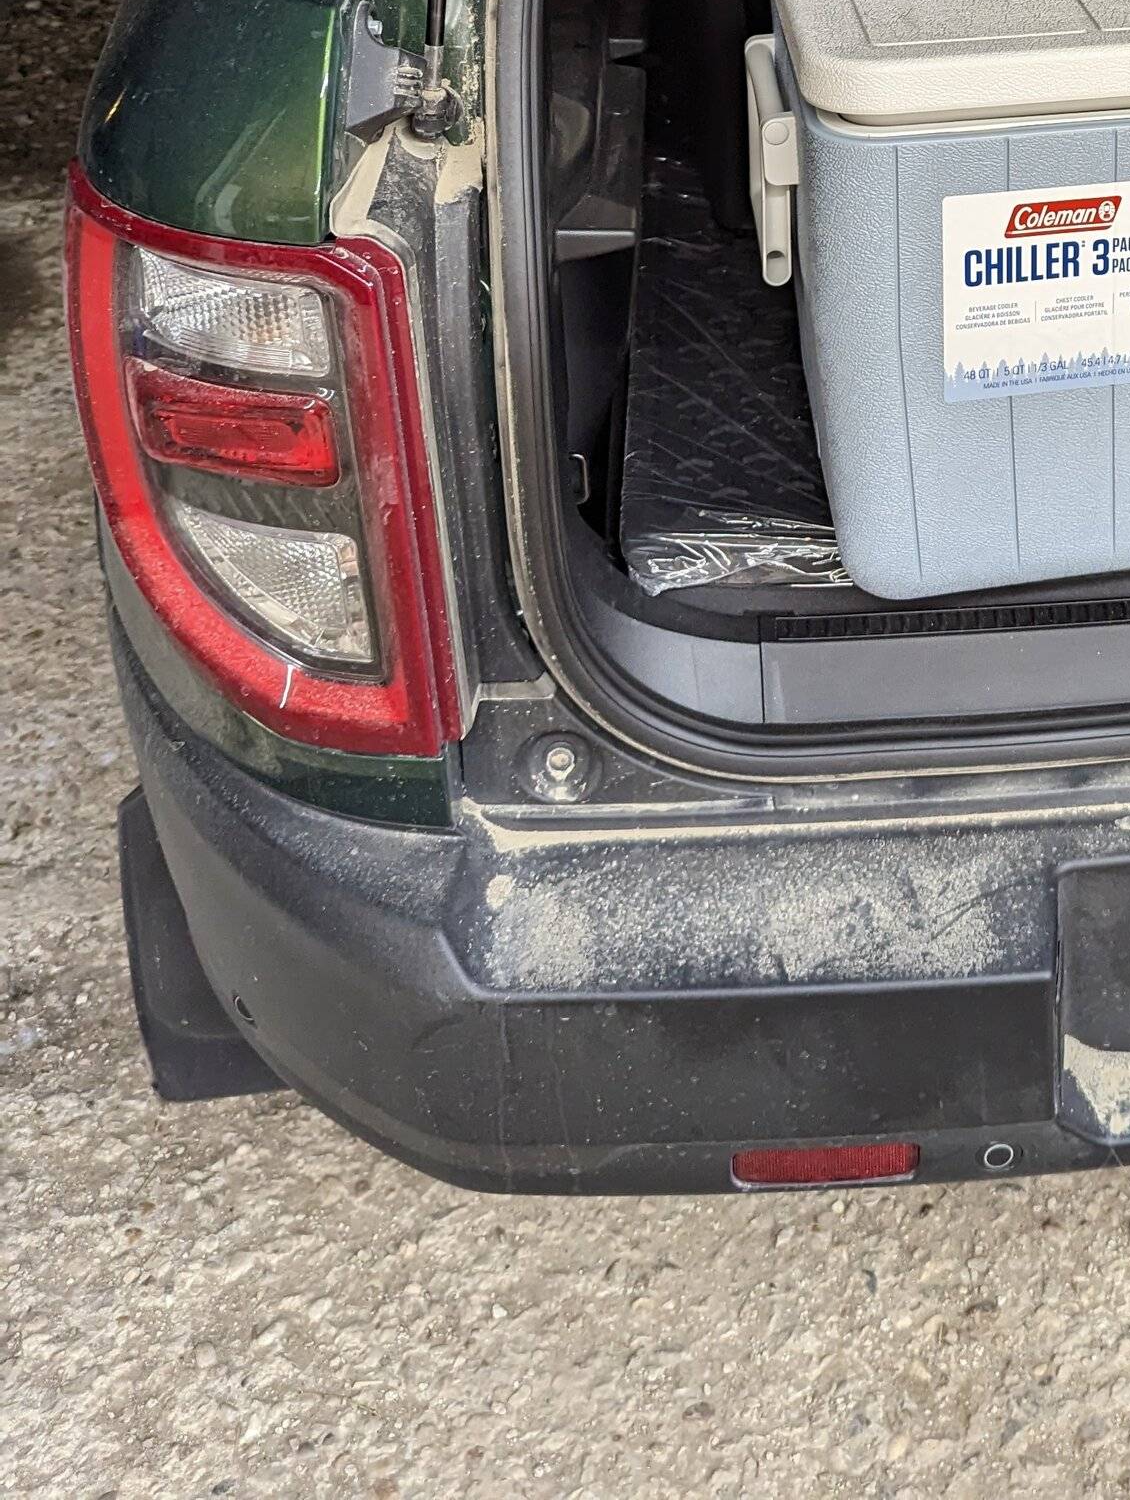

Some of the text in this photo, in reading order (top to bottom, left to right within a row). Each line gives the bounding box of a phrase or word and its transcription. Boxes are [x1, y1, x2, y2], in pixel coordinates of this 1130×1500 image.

[1014, 202, 1097, 231] Coleman
[964, 241, 1080, 288] CHILLER
[1092, 239, 1110, 276] 3
[964, 370, 975, 380] 48
[979, 369, 991, 378] QT
[1004, 366, 1010, 376] 5
[1012, 365, 1024, 375] QT
[1049, 360, 1069, 370] GAL
